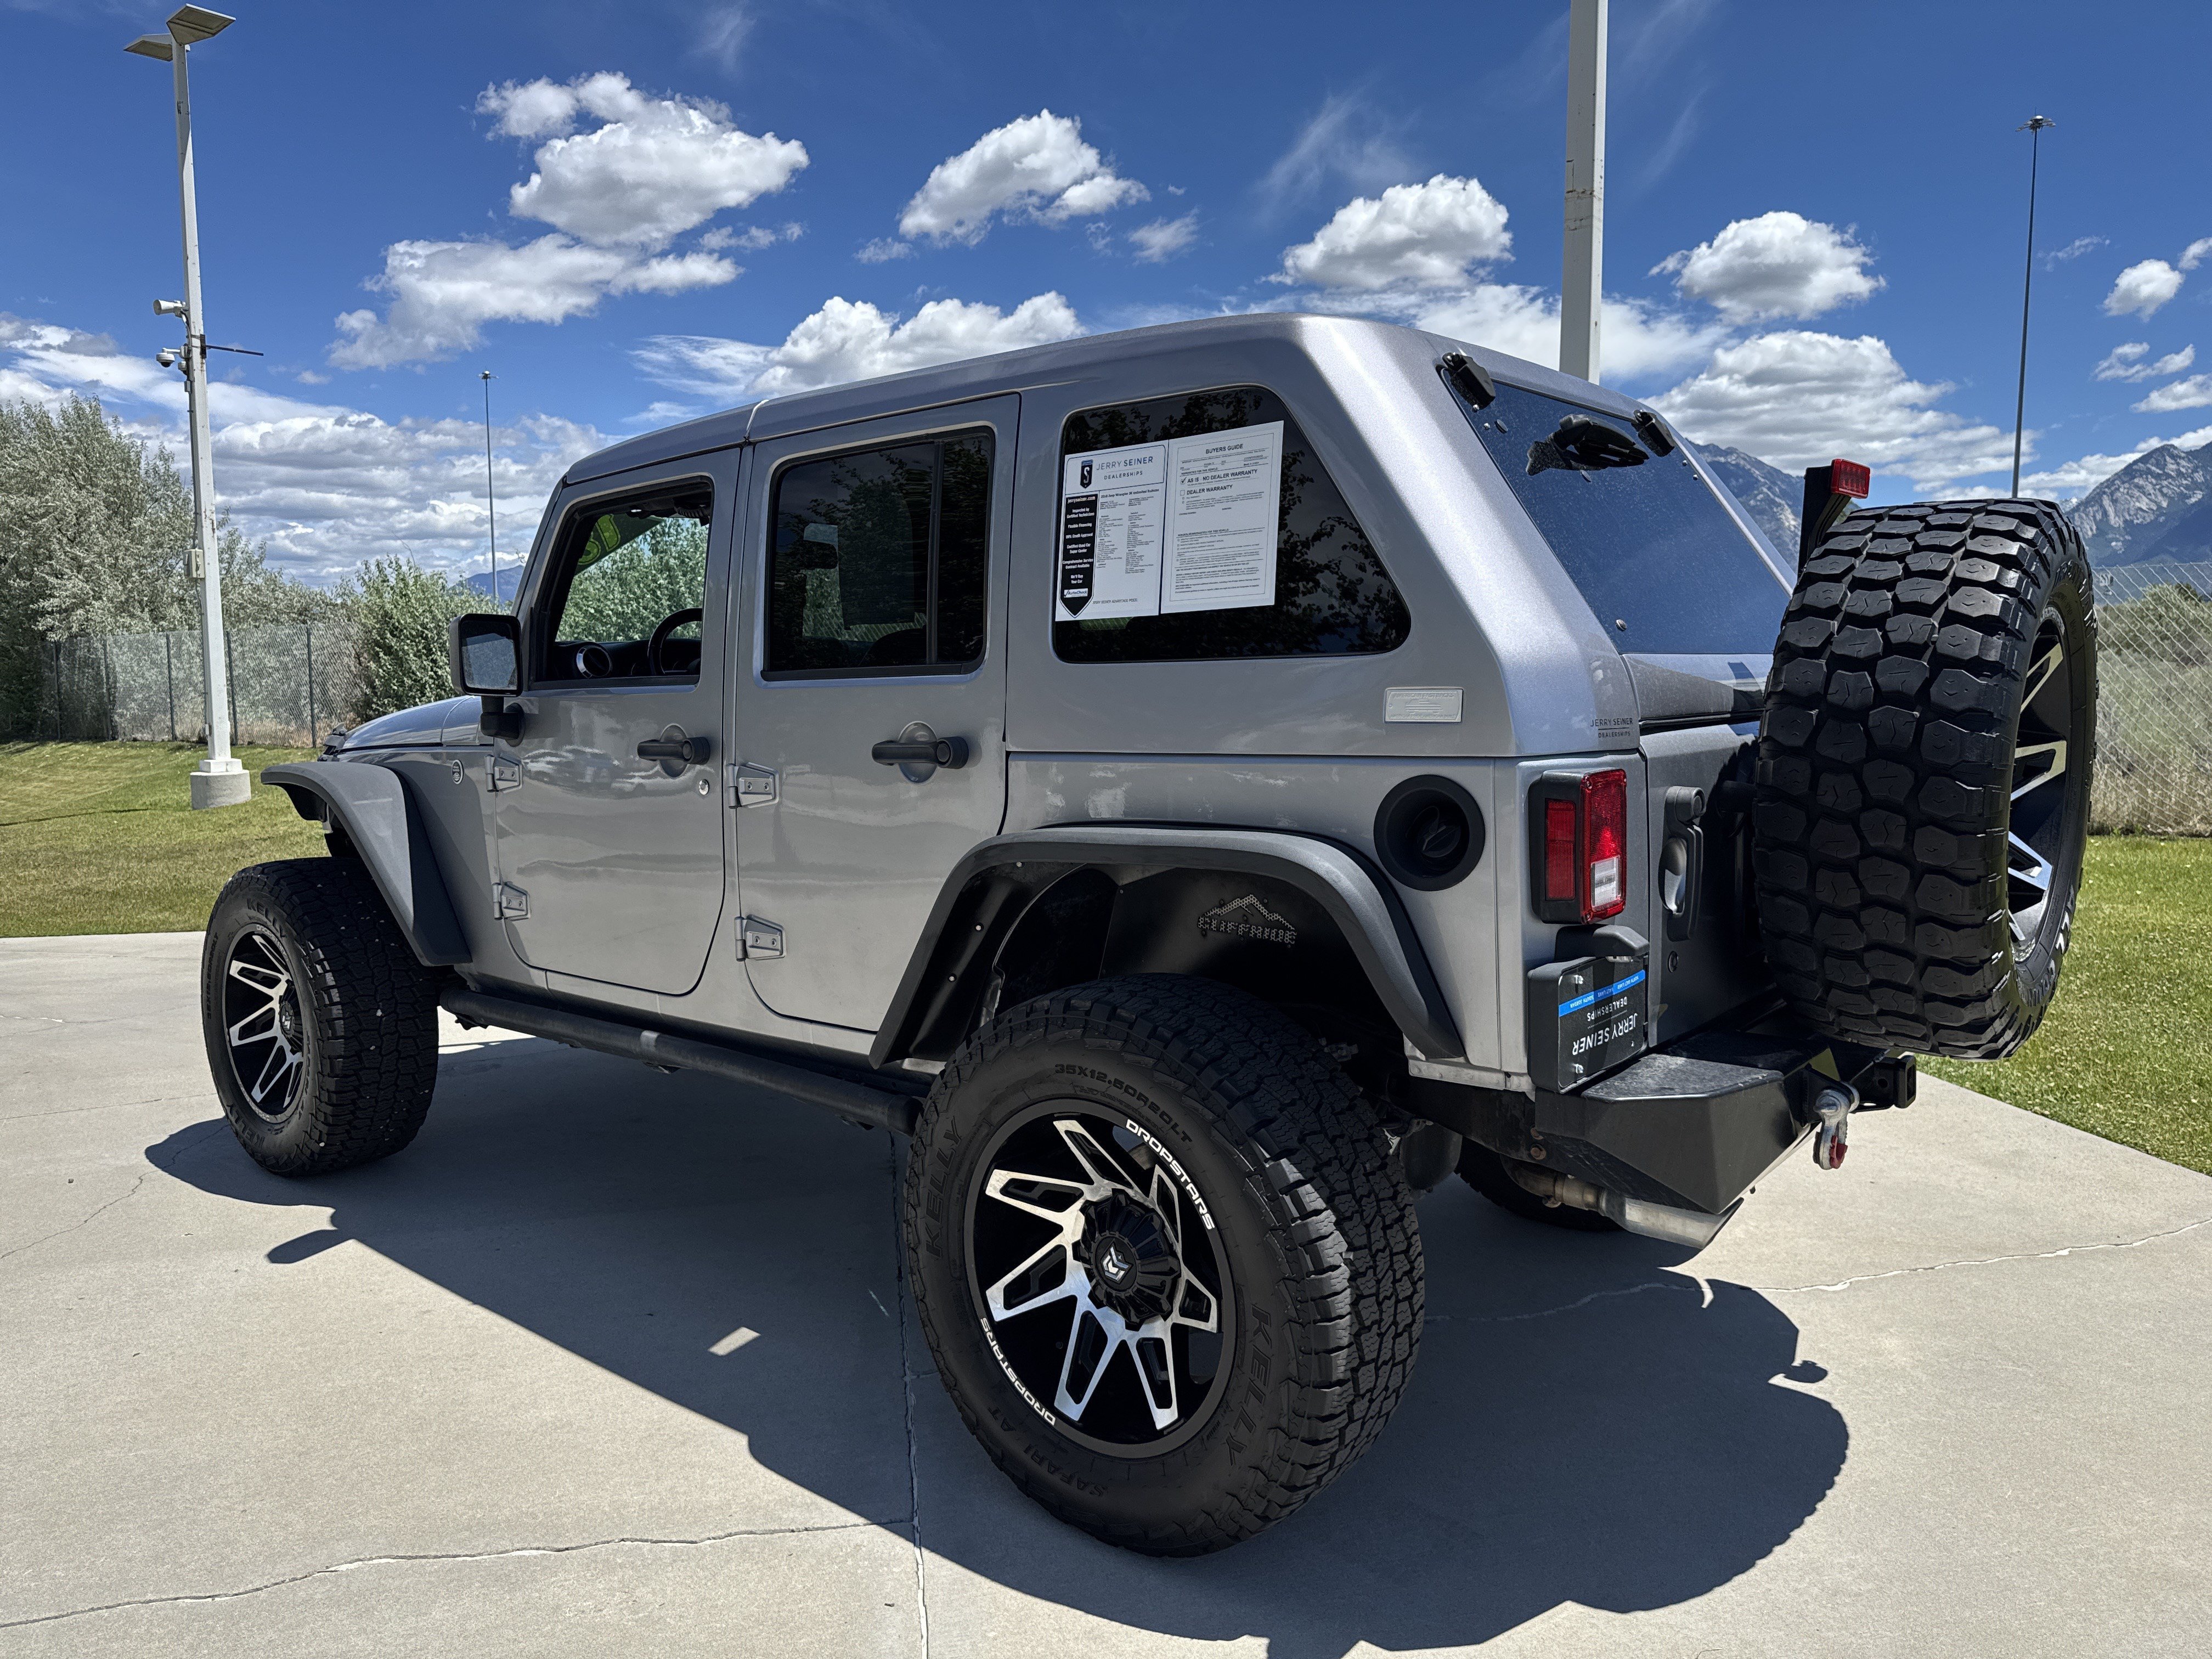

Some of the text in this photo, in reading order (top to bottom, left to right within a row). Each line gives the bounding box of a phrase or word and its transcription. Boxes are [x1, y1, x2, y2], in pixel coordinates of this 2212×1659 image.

[1097, 461, 1121, 470] JERRY
[1124, 456, 1153, 466] SEINER
[1104, 471, 1142, 479] DEALERSHIPS
[1231, 469, 1257, 477] WARRANTY
[1590, 719, 1611, 727] JERRY
[1587, 996, 1627, 1022] DEALERSHIPS
[1572, 1013, 1638, 1056] JERRY SEINER
[1054, 1064, 1193, 1142] 35X12.50R20LT
[227, 1103, 266, 1148] KELLY
[925, 1116, 962, 1259] KELLY
[1126, 1118, 1215, 1230] DROPSTARS
[980, 1317, 1057, 1425] DROPSTARS
[1226, 1304, 1272, 1466] KELLY
